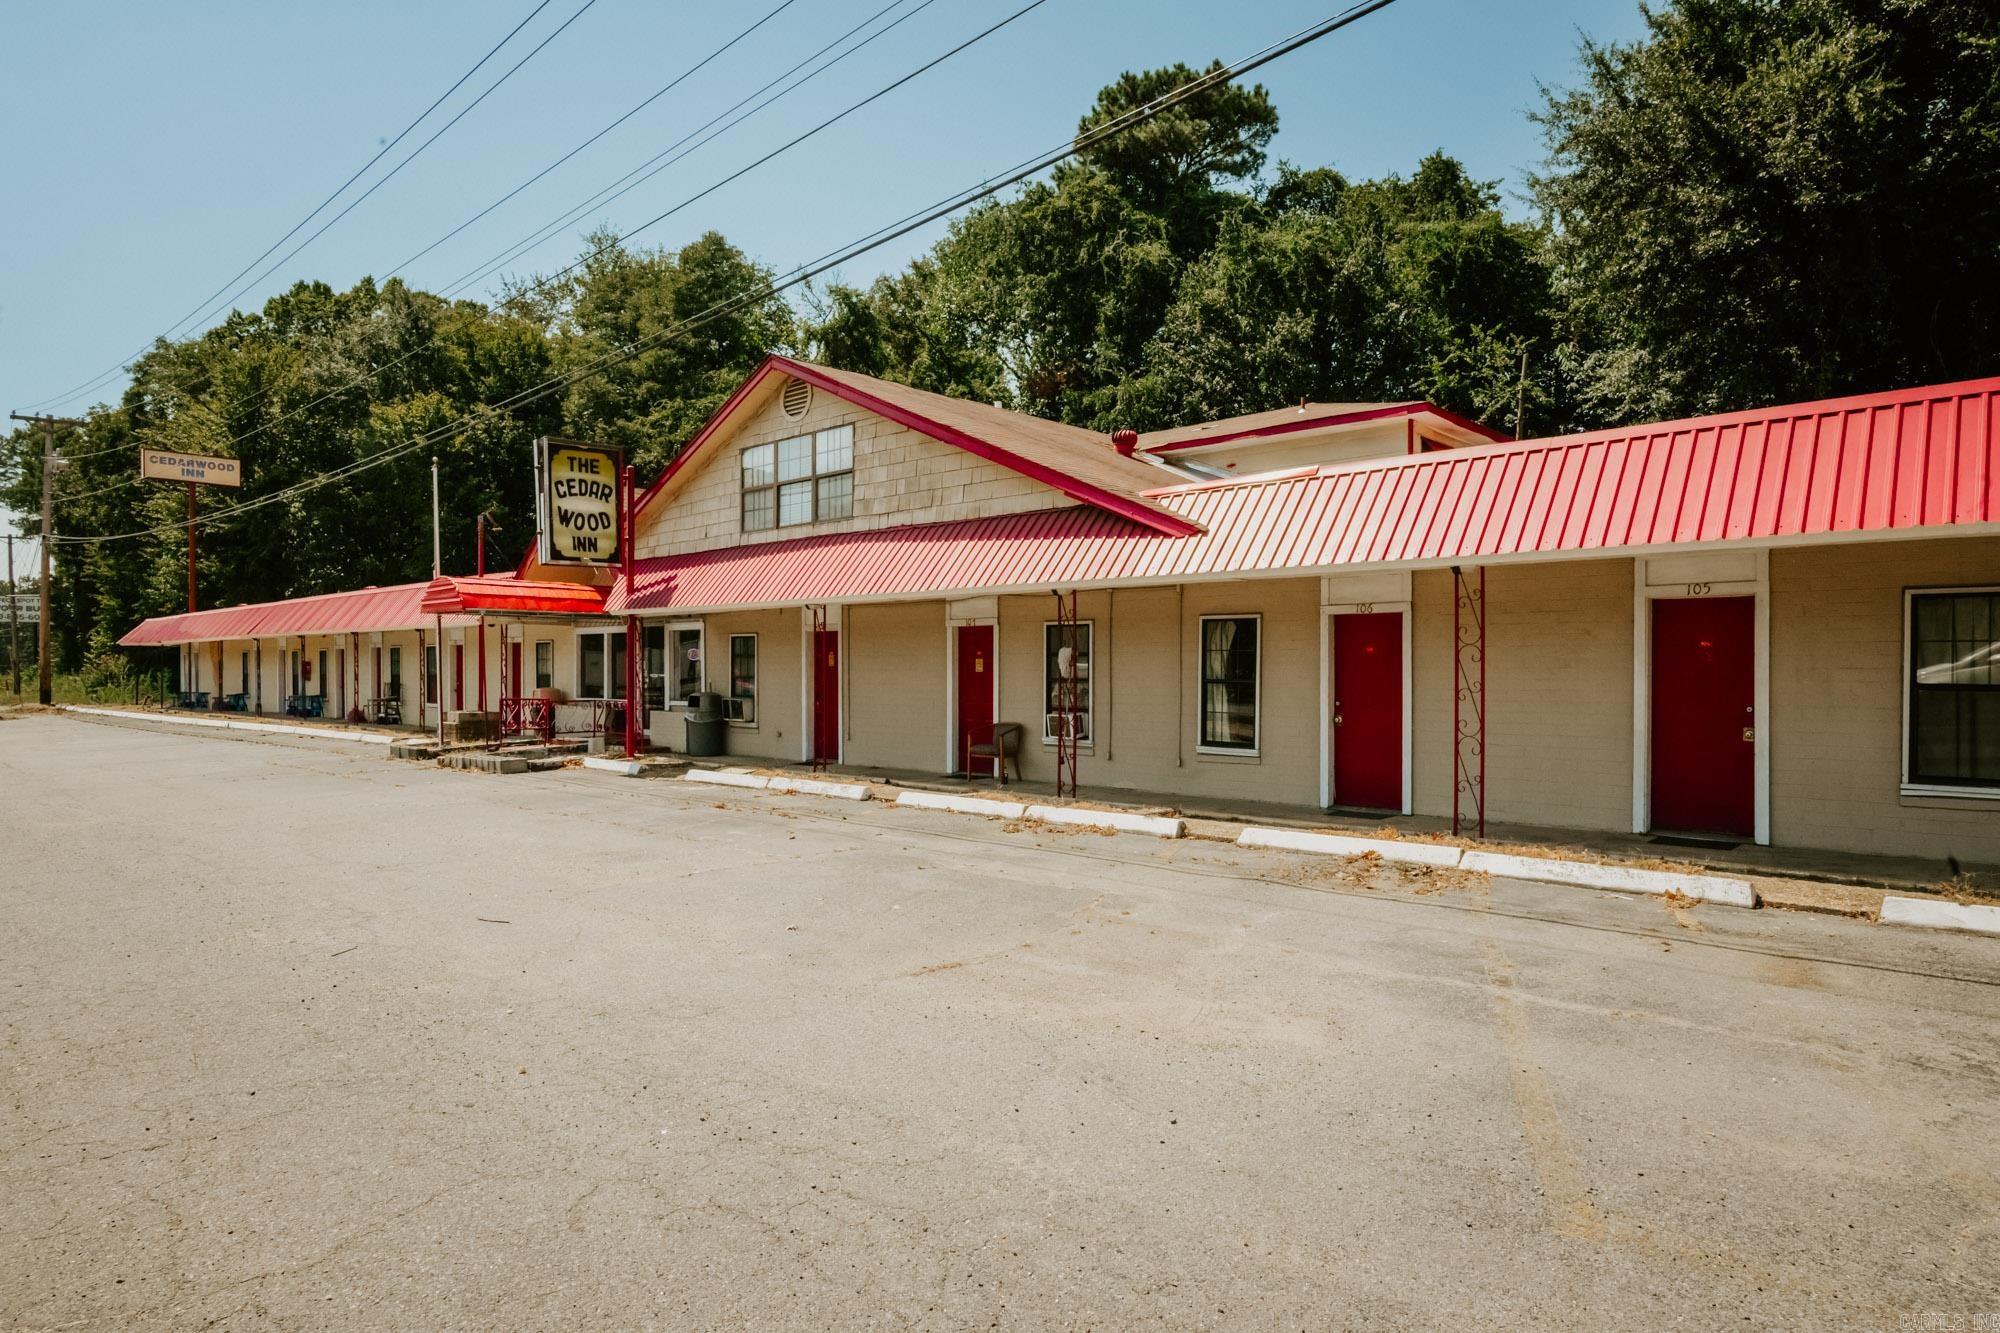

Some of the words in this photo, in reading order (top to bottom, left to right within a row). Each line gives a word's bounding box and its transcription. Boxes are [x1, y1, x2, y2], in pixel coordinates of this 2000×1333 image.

[149, 455, 235, 472] CEDARWOOD
[567, 456, 600, 475] THE
[181, 468, 205, 478] INN
[554, 478, 614, 503] CEDAR
[557, 505, 611, 531] WOOD
[572, 535, 598, 553] INN
[1686, 582, 1711, 595] 105
[1356, 602, 1376, 614] 106
